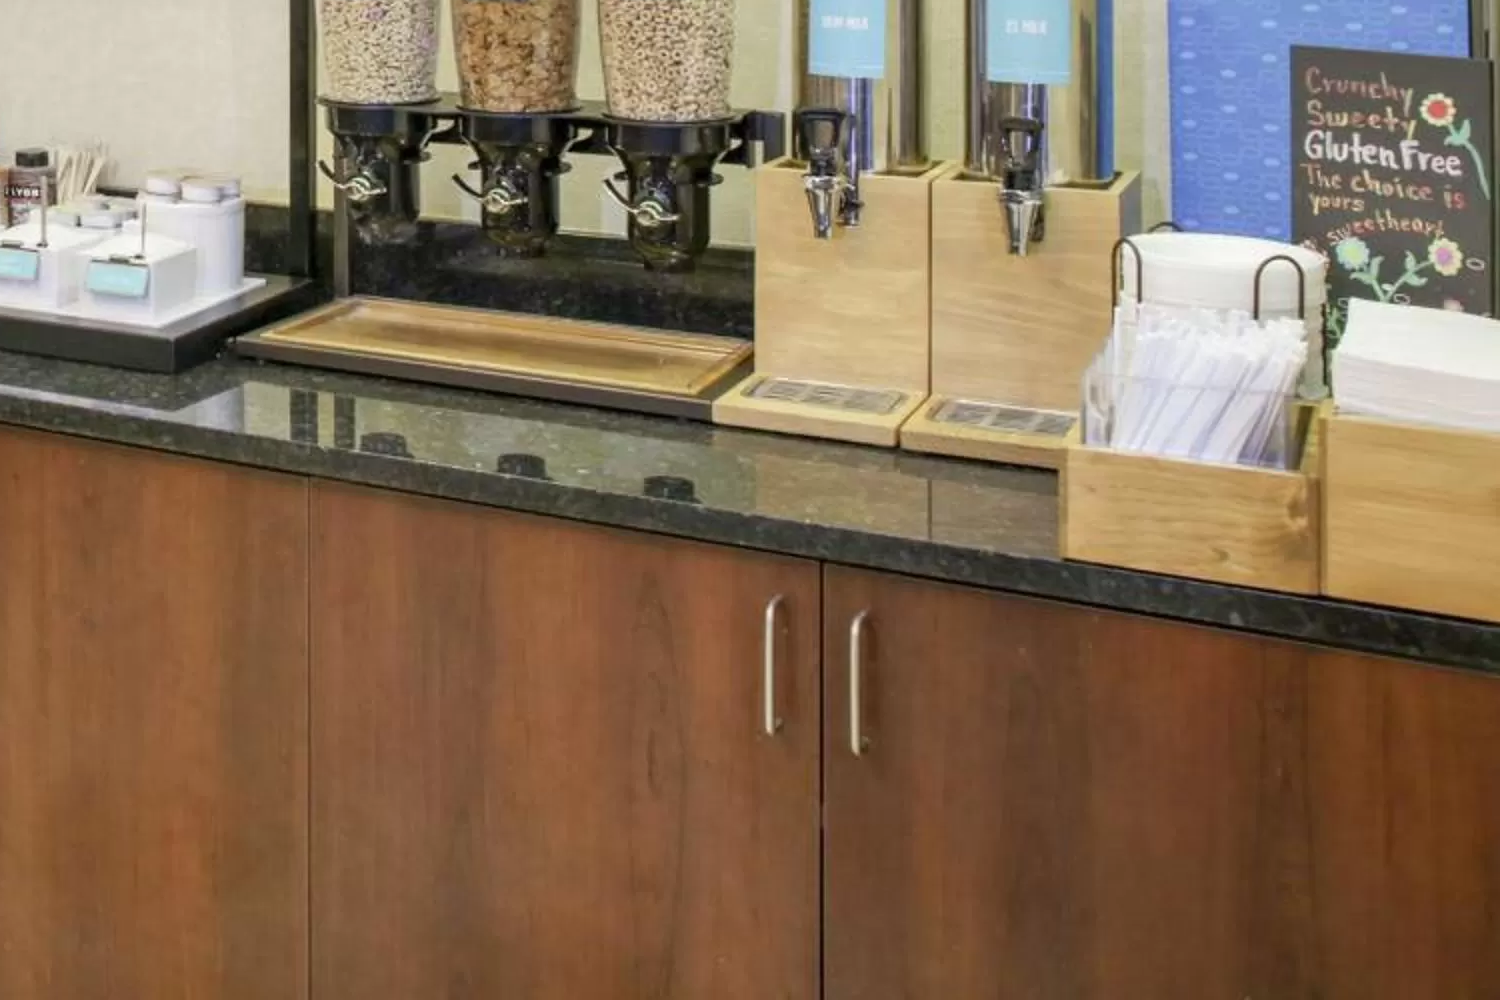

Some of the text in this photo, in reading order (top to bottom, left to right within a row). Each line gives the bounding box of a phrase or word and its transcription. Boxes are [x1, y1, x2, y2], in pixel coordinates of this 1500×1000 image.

[1305, 65, 1414, 118] Crunchy
[1300, 163, 1466, 210] The choice is
[1308, 190, 1366, 217] yours
